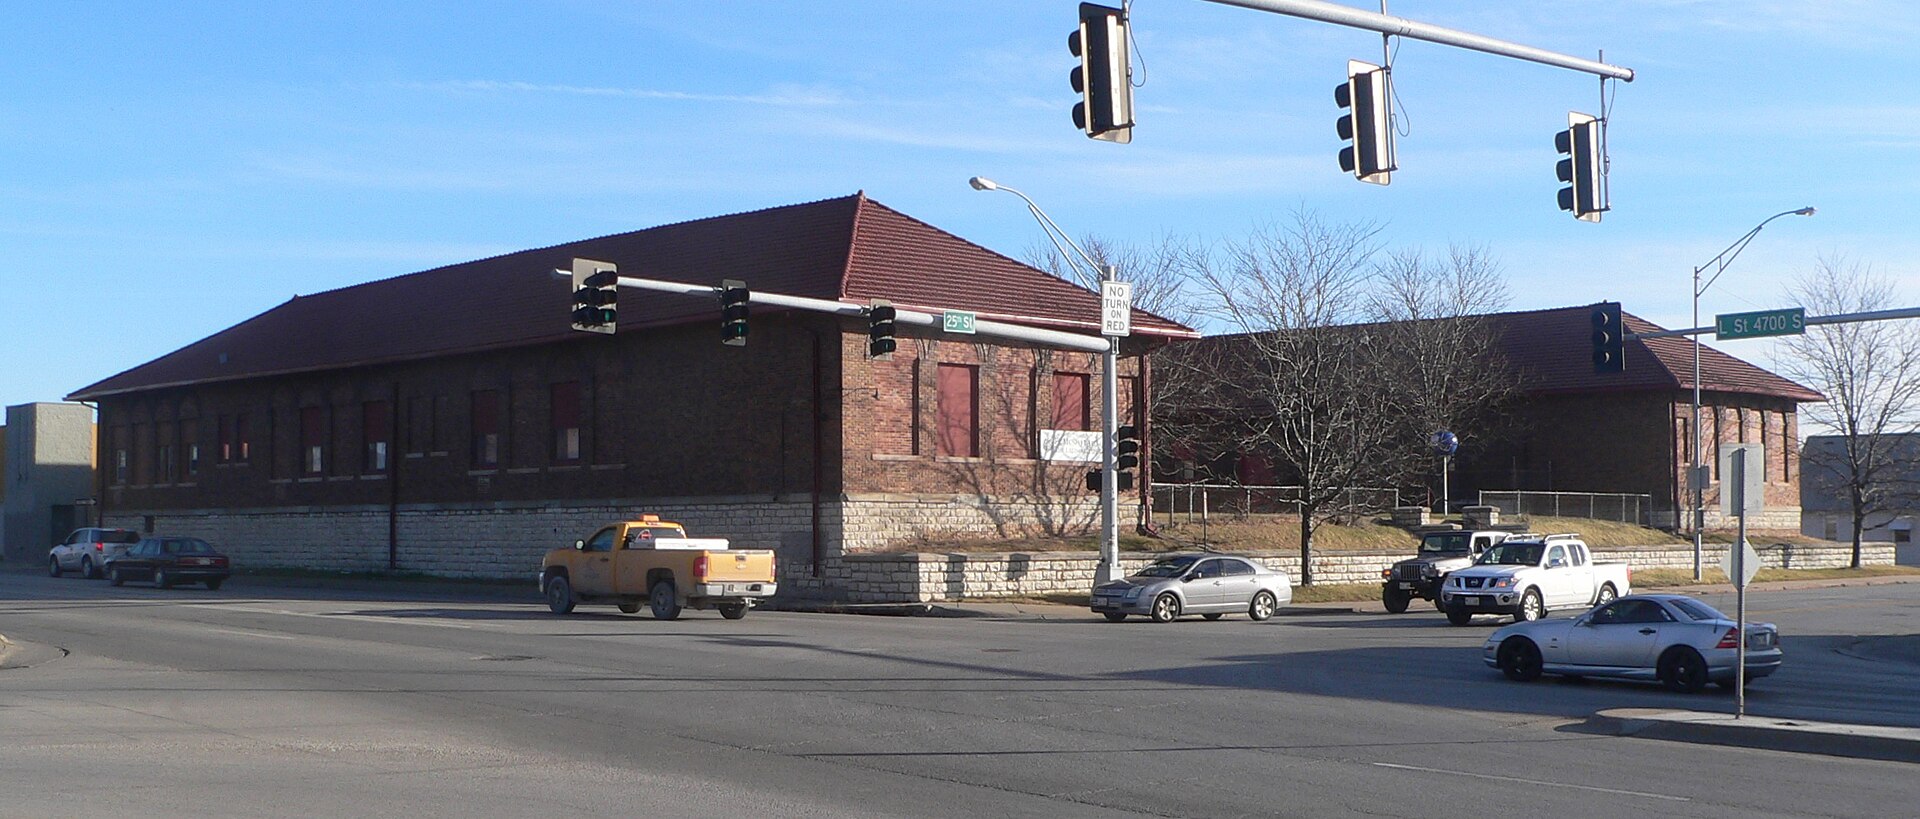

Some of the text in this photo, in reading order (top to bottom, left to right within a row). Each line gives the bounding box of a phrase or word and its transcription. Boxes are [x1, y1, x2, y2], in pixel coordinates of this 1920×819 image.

[1109, 286, 1124, 297] NO
[1105, 299, 1129, 310] TURN
[1110, 310, 1122, 319] ON
[1106, 320, 1125, 331] RED
[1719, 313, 1801, 334] L St 4700 S
